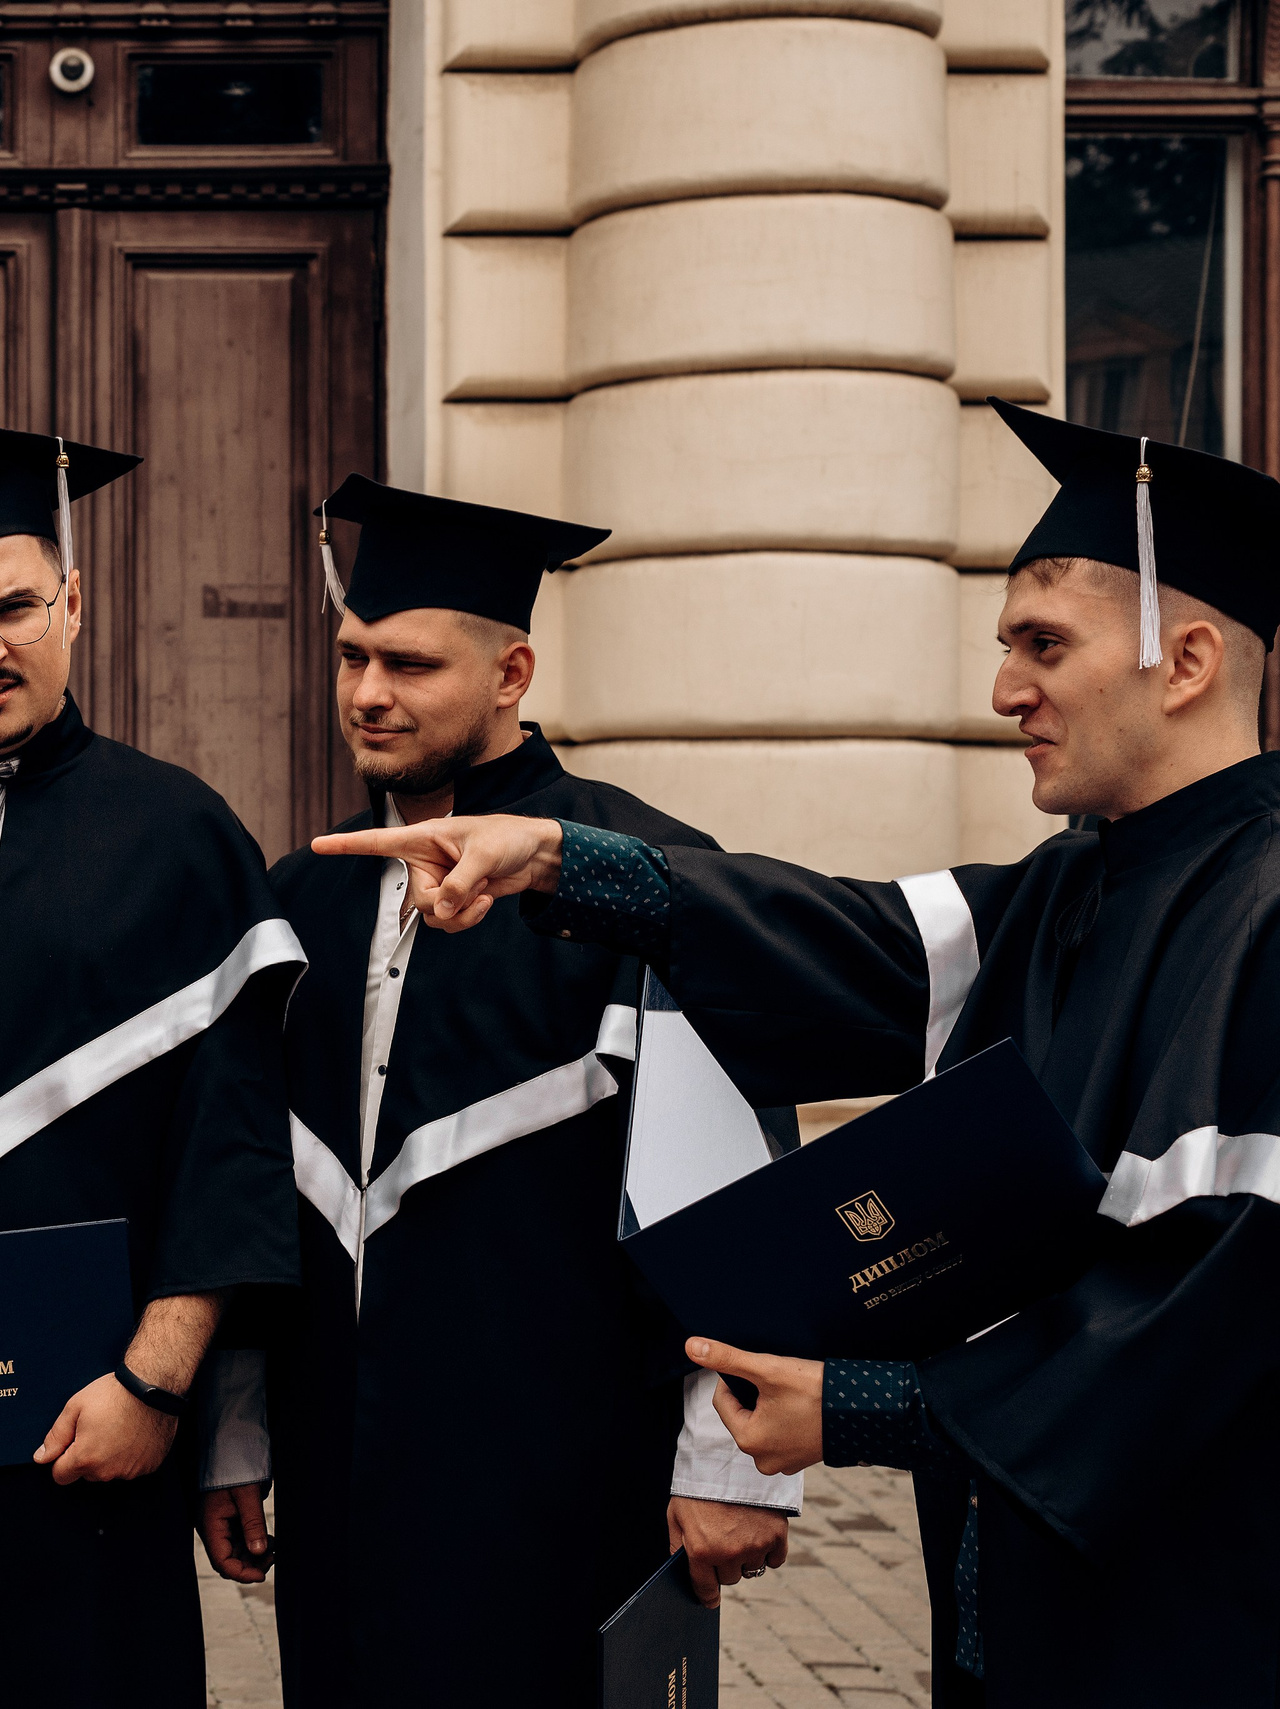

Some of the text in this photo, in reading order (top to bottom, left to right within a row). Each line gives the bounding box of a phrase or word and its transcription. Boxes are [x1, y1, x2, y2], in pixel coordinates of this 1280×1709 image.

[848, 1231, 950, 1294] ДИПЛОМ
[863, 1292, 889, 1310] ПРО
[668, 1668, 676, 1709] ЛОМ
